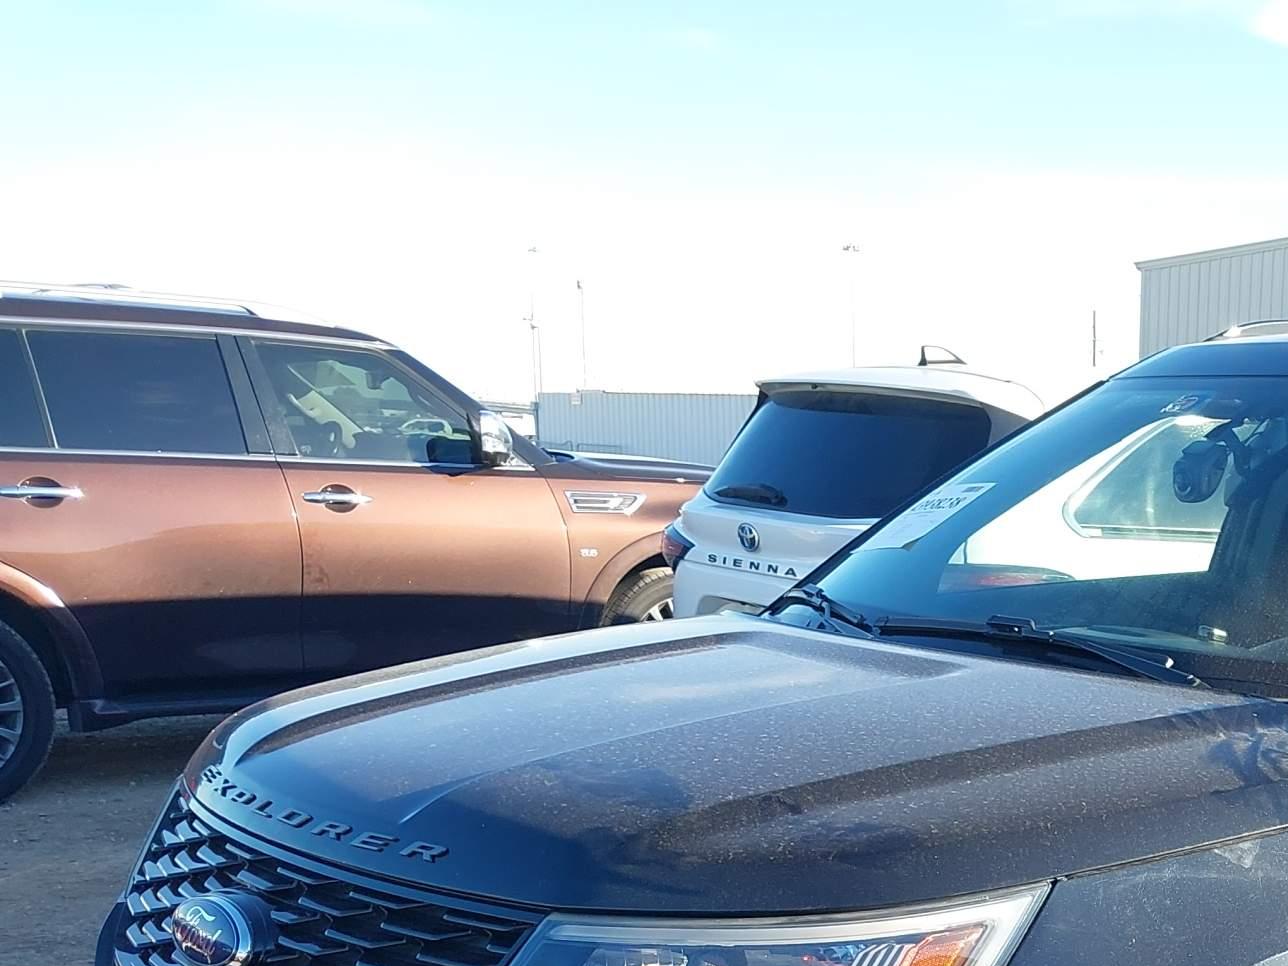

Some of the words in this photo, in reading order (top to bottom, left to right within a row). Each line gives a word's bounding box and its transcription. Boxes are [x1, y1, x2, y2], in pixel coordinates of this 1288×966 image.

[707, 554, 797, 577] SIENNA
[201, 764, 450, 864] EXPLORER
[181, 905, 223, 964] Ford
